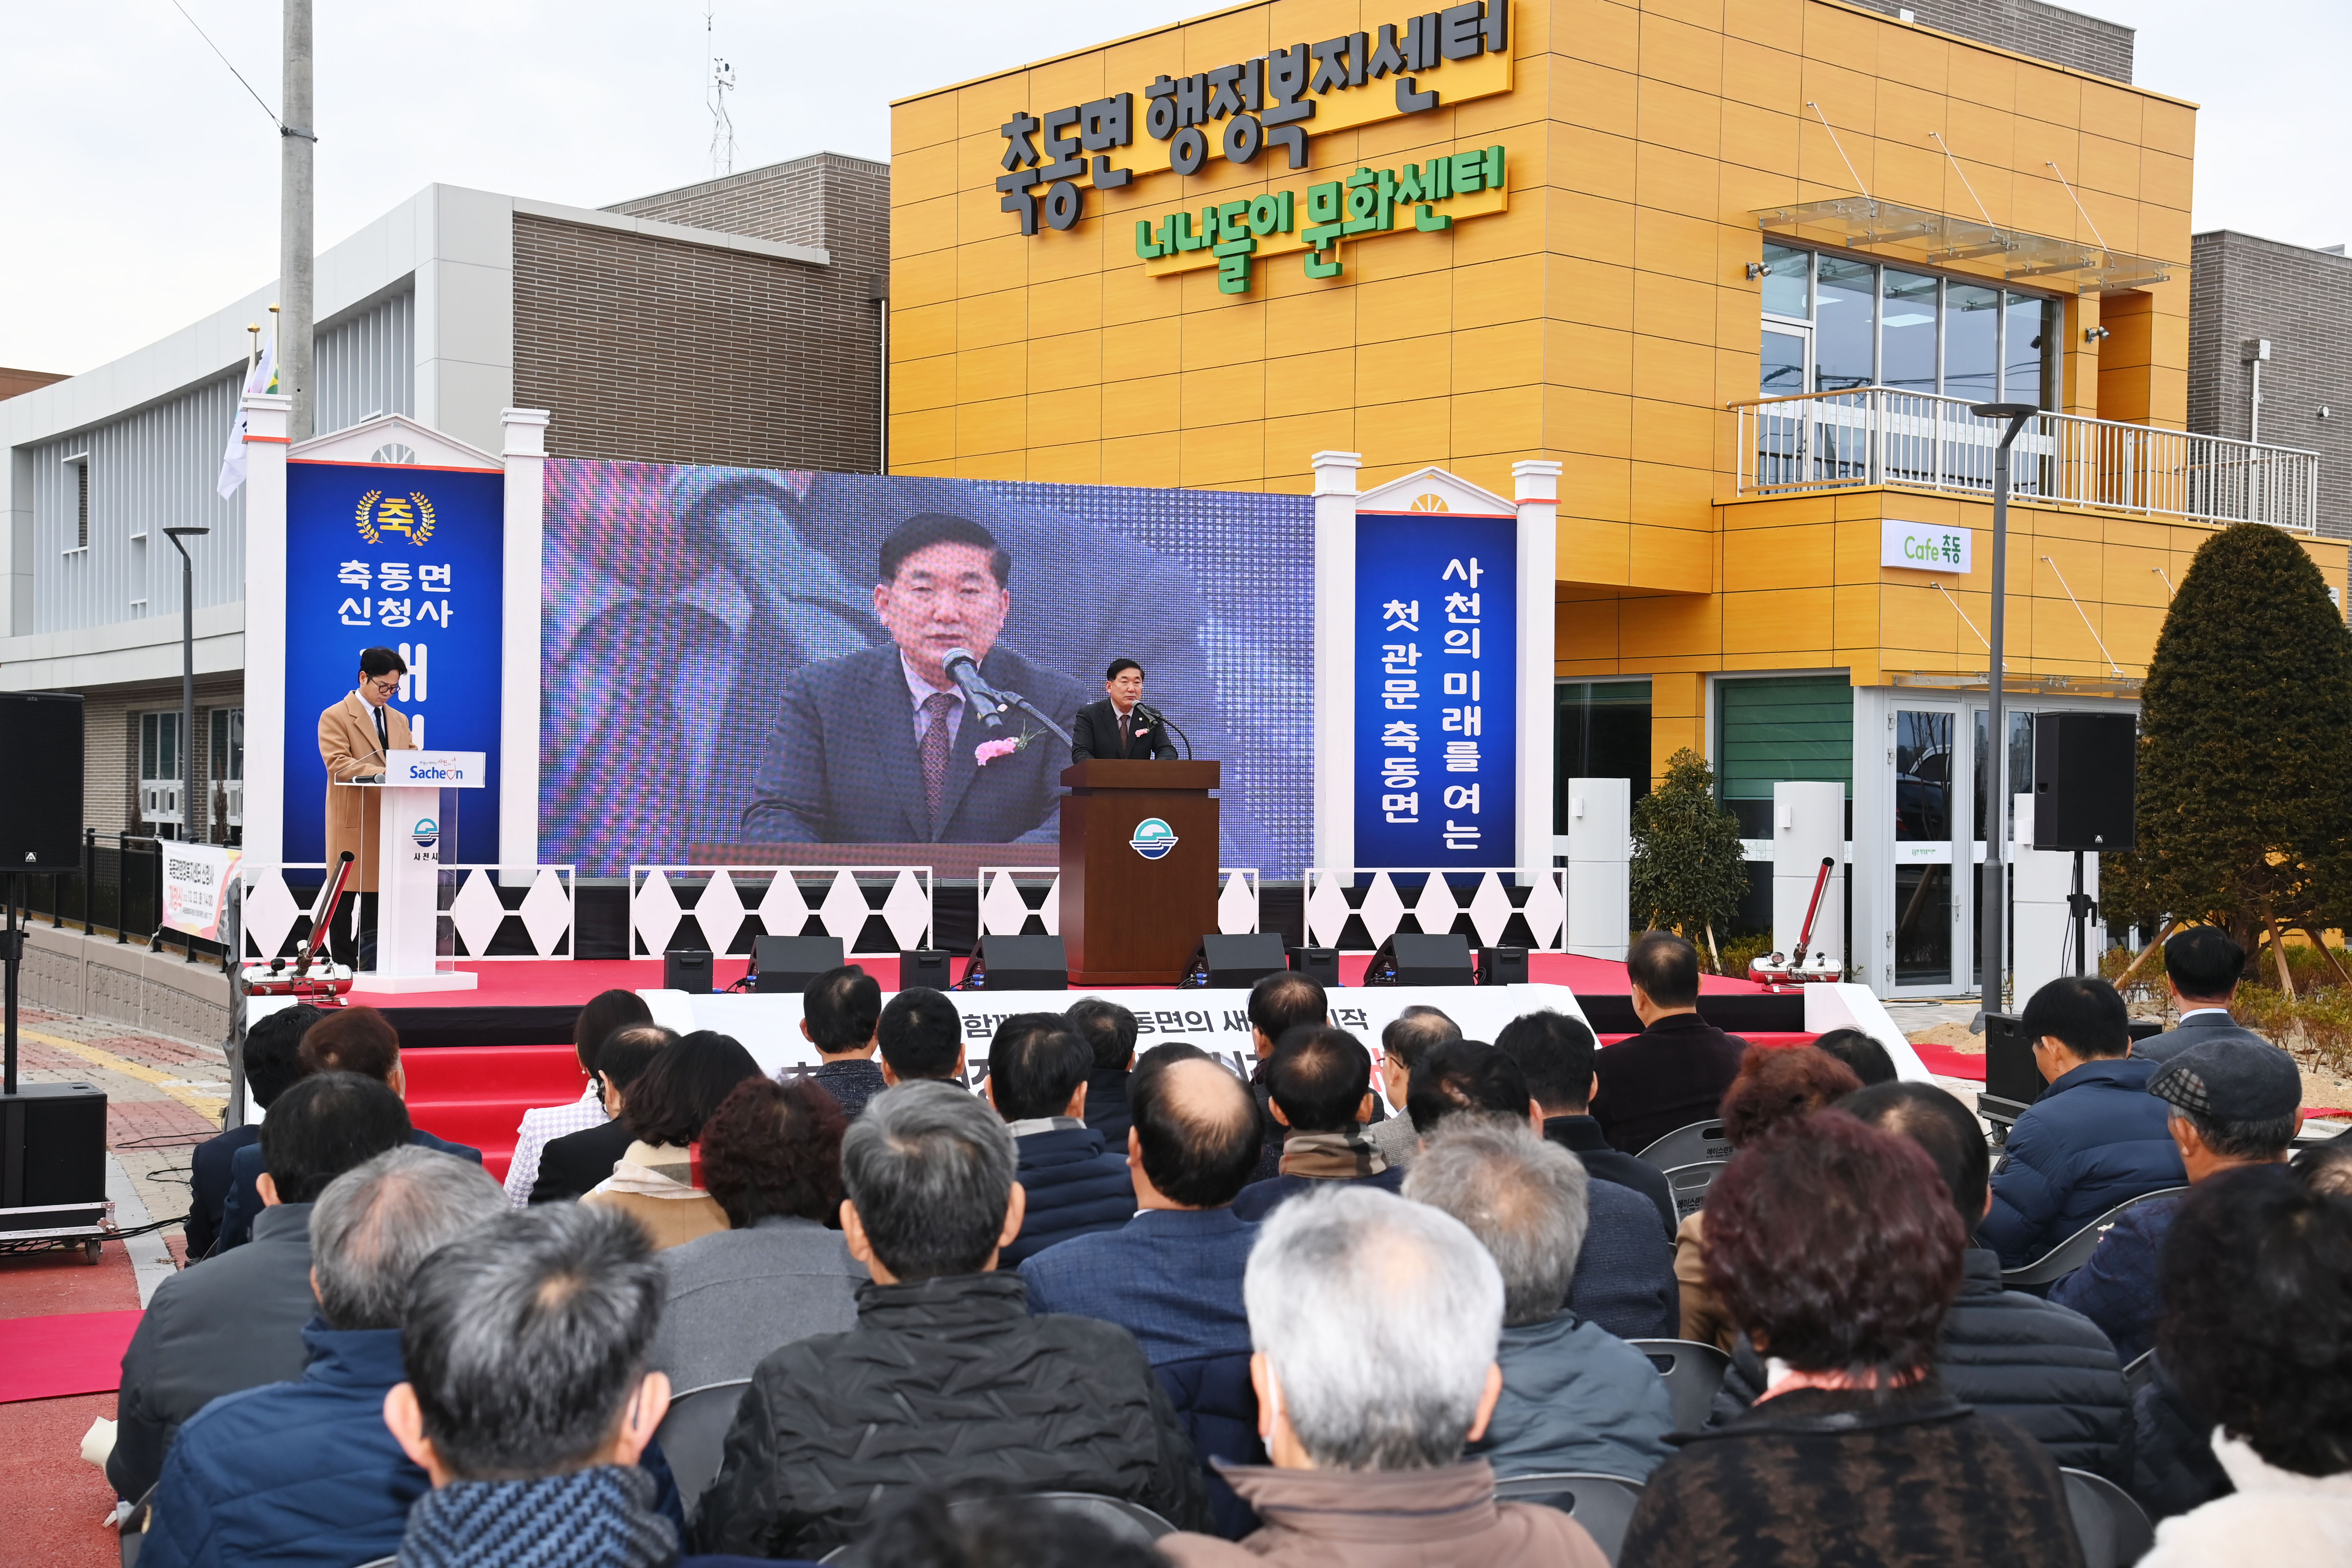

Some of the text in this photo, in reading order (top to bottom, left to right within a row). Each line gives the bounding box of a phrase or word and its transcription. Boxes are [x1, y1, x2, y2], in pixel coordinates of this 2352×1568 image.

[996, 0, 1508, 236] 축동면 행정복지센터
[1135, 146, 1505, 295] 너나들이 문화센터
[376, 497, 414, 537] 축
[1905, 534, 1961, 564] Cafe 축동
[338, 560, 452, 593] 축동면
[338, 597, 453, 629] 신청사
[1380, 599, 1422, 823] 첫 관문 축동면
[1442, 557, 1484, 849] 사천의 미래를 여는
[410, 765, 463, 780] Sacheon
[414, 852, 438, 860] 사천시
[1136, 1010, 1214, 1034] 동면의
